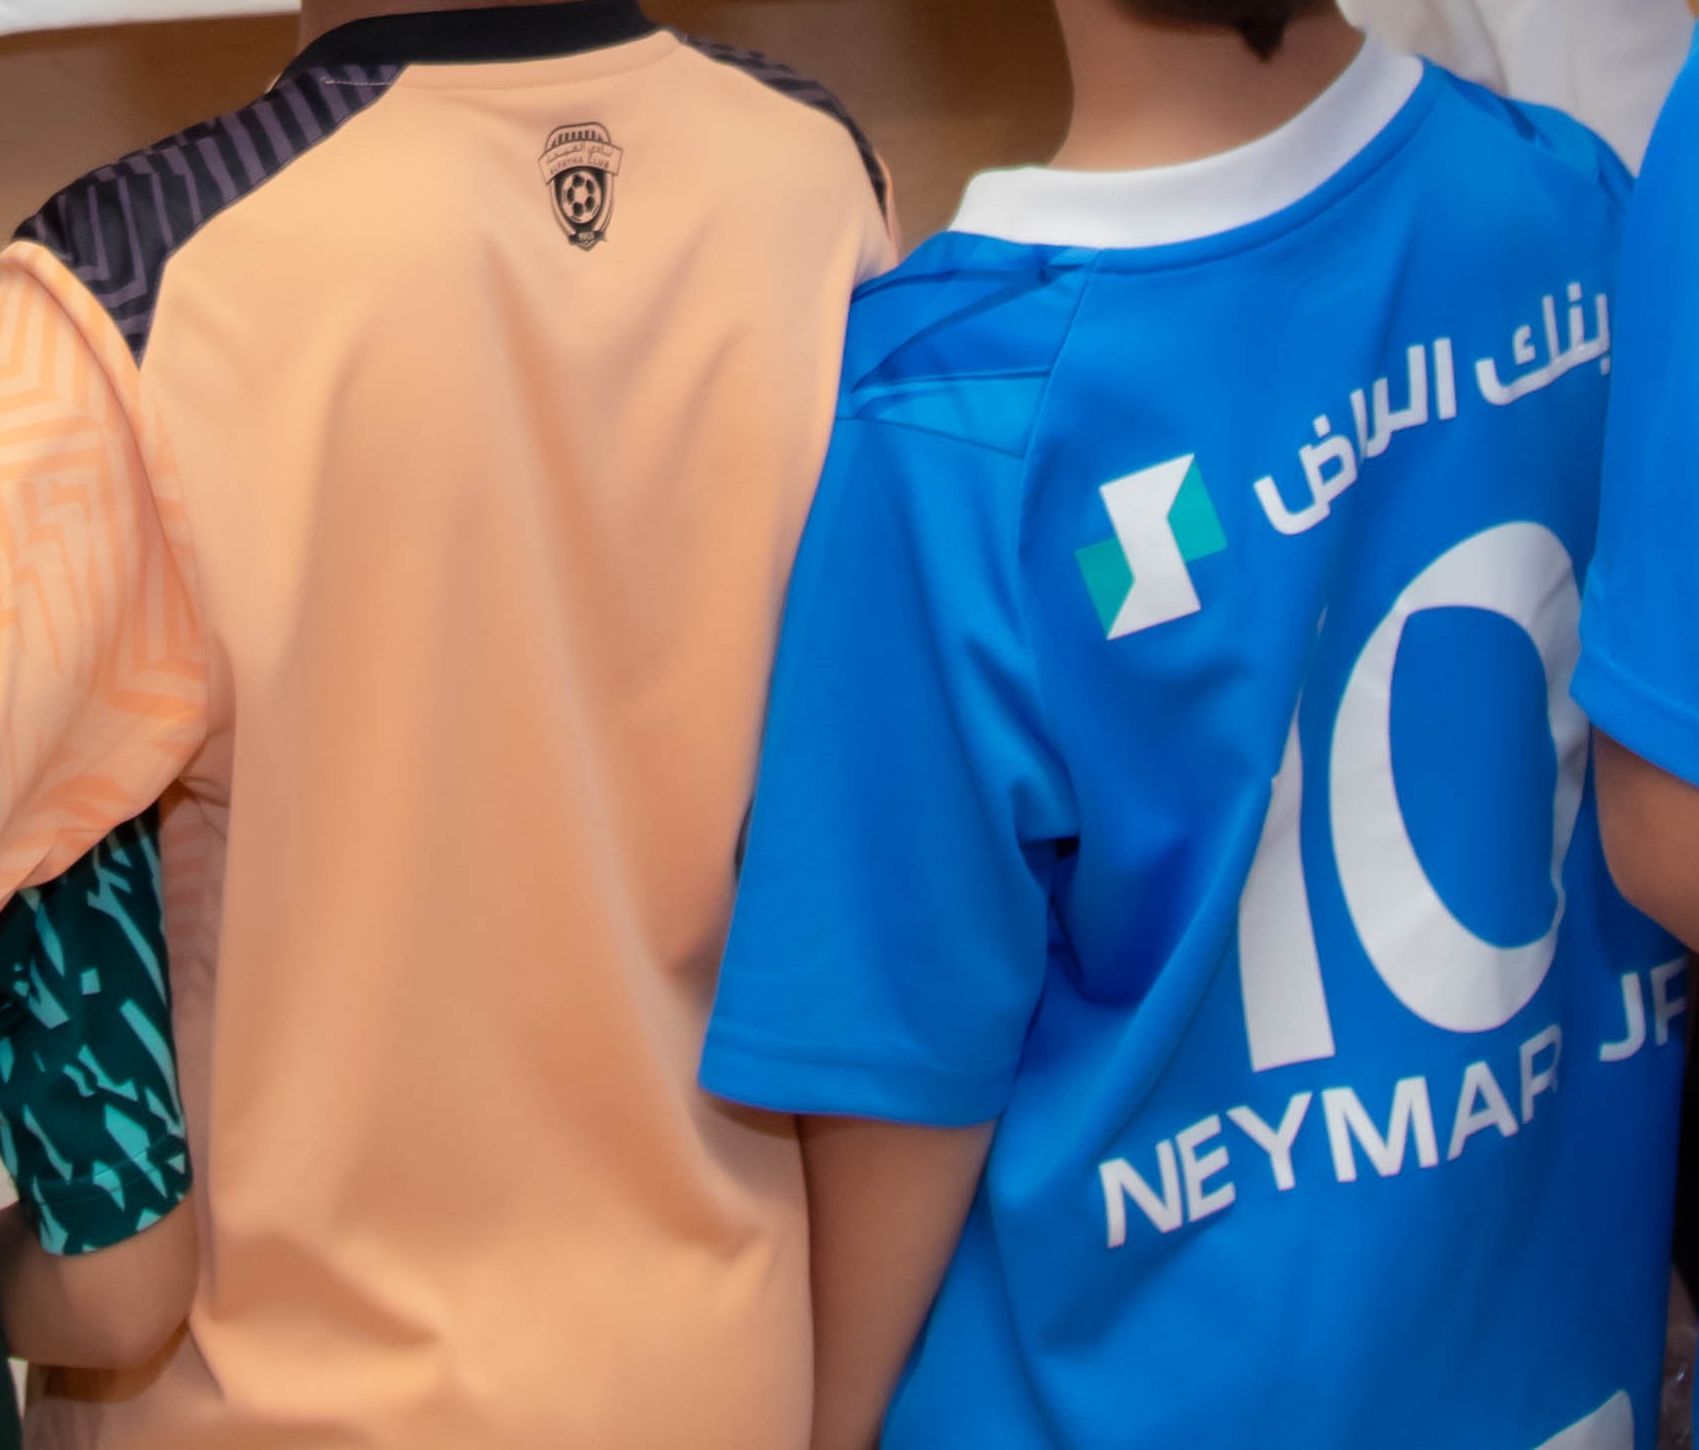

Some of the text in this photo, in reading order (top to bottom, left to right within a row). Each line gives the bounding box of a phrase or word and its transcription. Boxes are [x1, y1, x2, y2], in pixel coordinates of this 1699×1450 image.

[1473, 280, 1612, 406] بنك
[1238, 520, 1590, 1073] 10
[1098, 1022, 1563, 1249] NEYMAR
